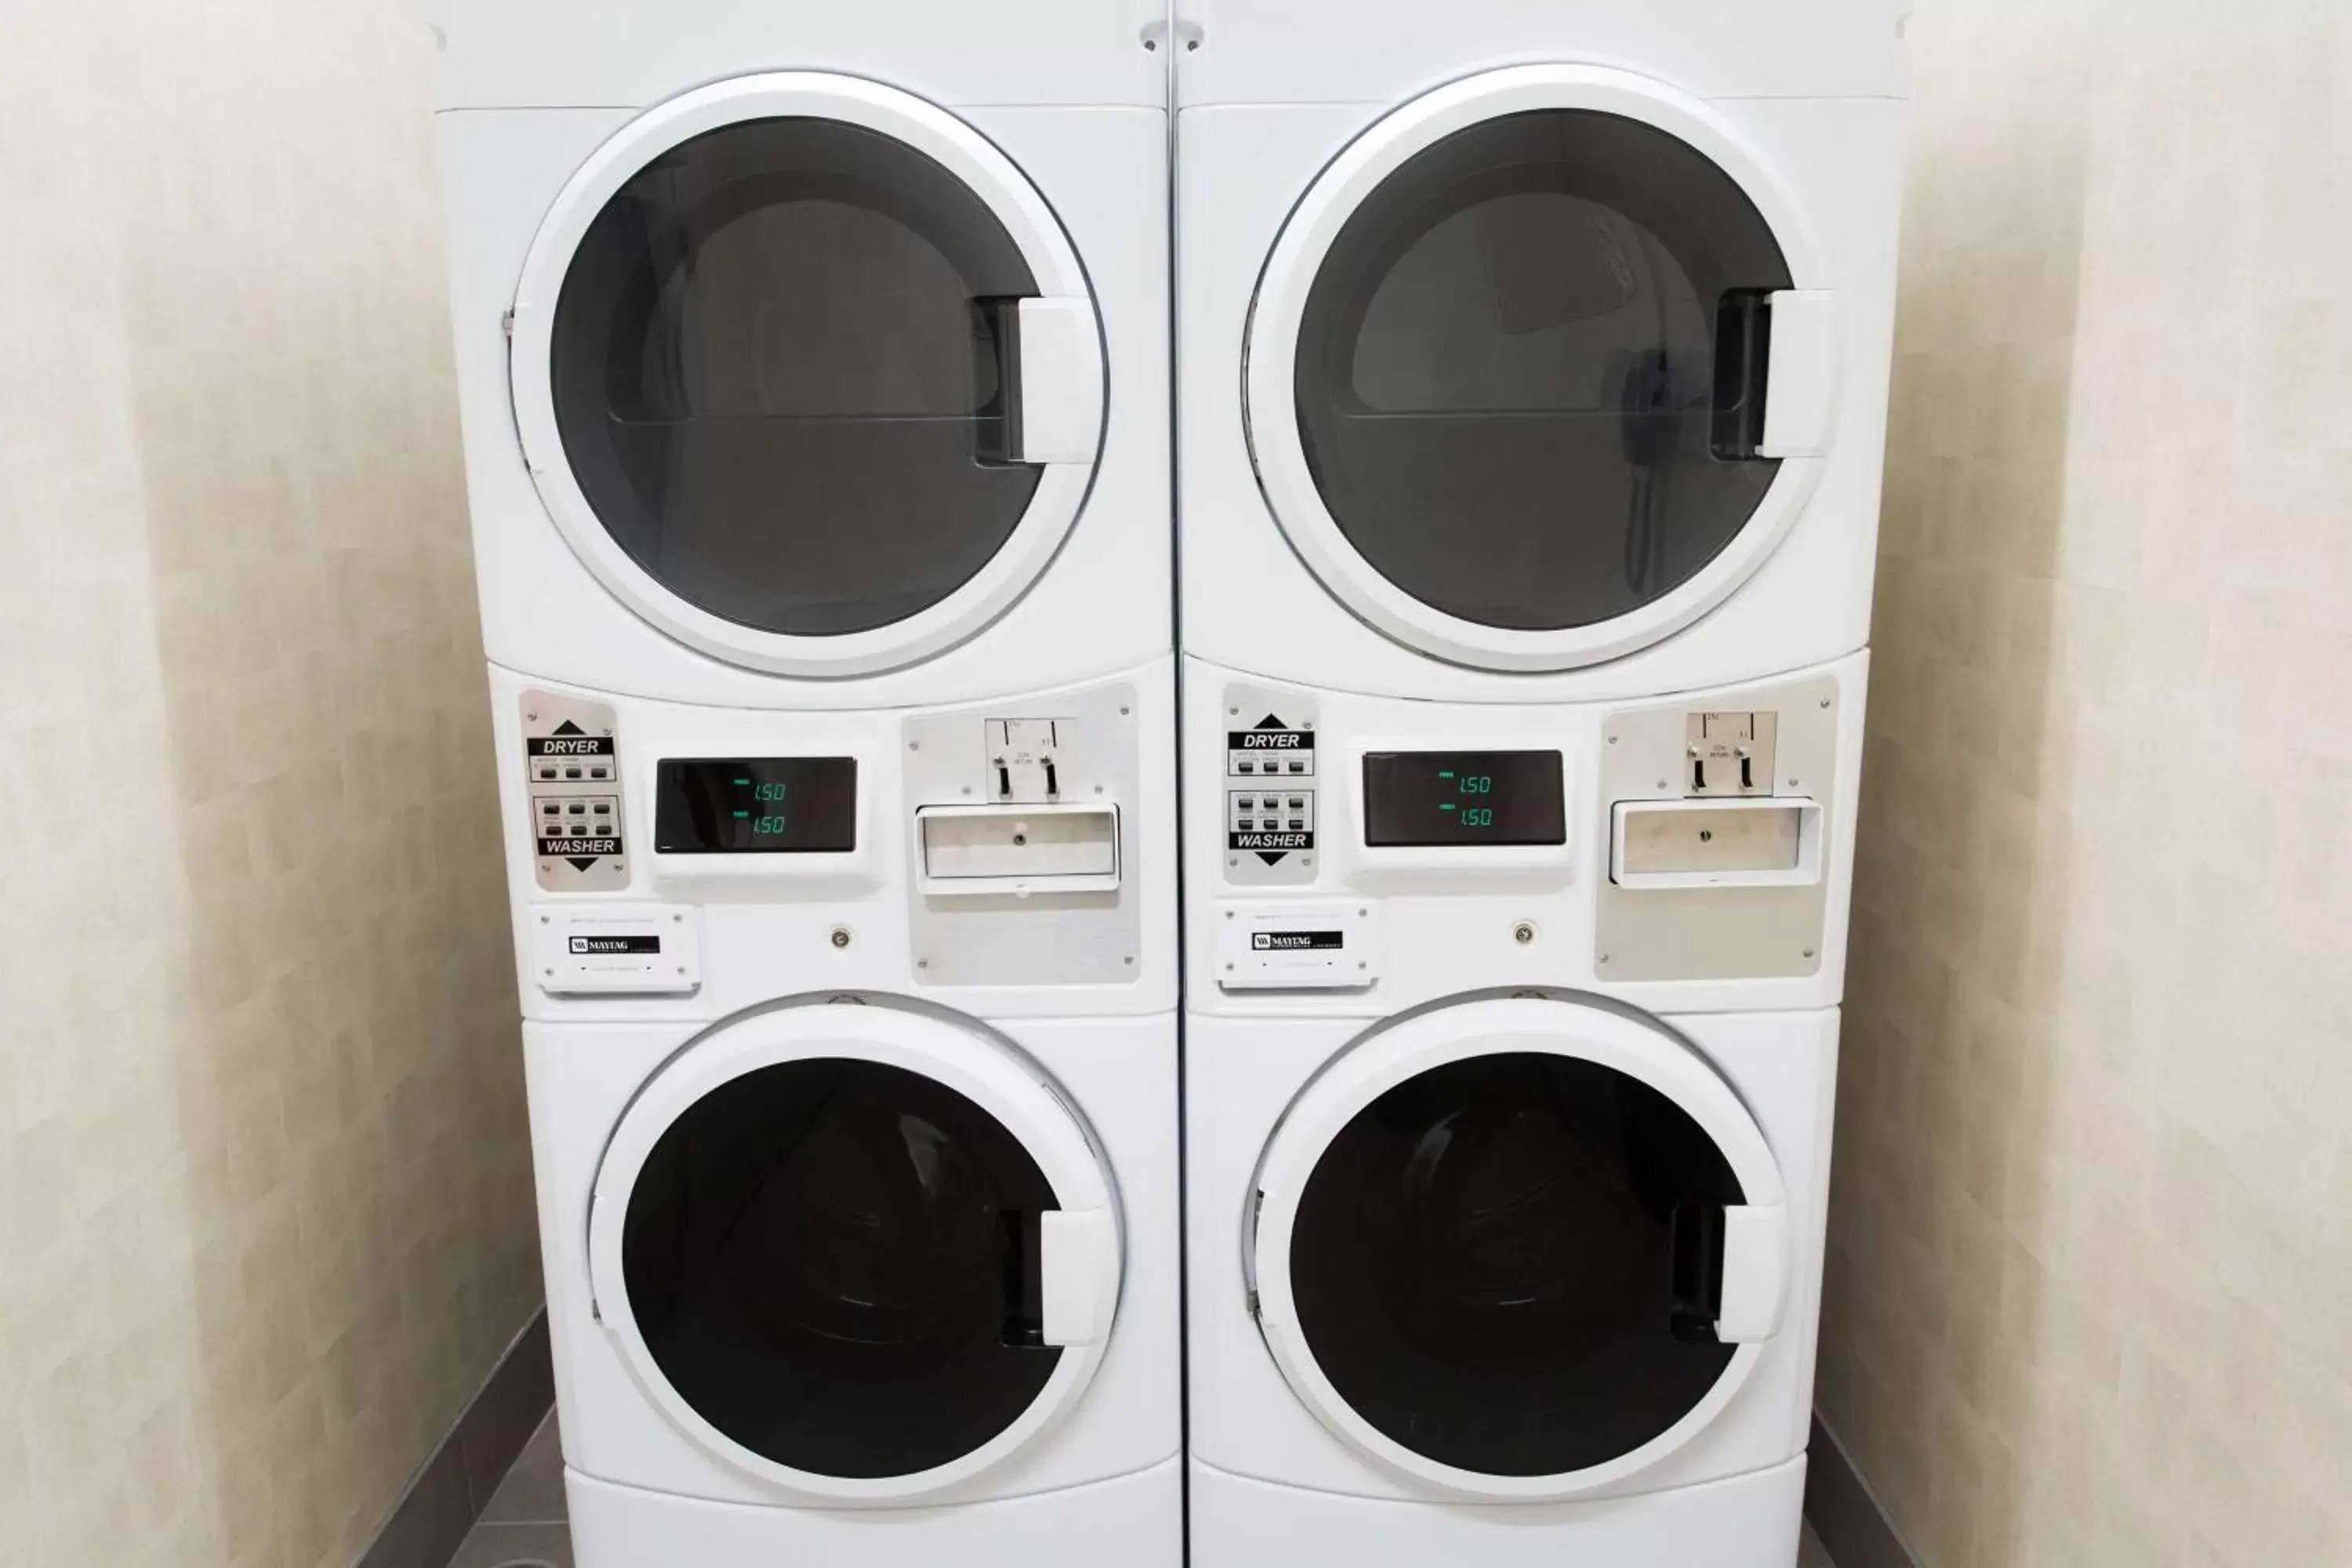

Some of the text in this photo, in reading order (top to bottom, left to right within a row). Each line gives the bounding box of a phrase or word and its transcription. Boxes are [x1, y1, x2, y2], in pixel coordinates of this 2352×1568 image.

[543, 740, 599, 753] DRYER
[1243, 735, 1300, 747] DRYER
[546, 840, 615, 853] WASHER
[1237, 834, 1307, 848] WASHER
[589, 940, 628, 949] MAYTAG
[1272, 936, 1312, 946] MAYTAG
